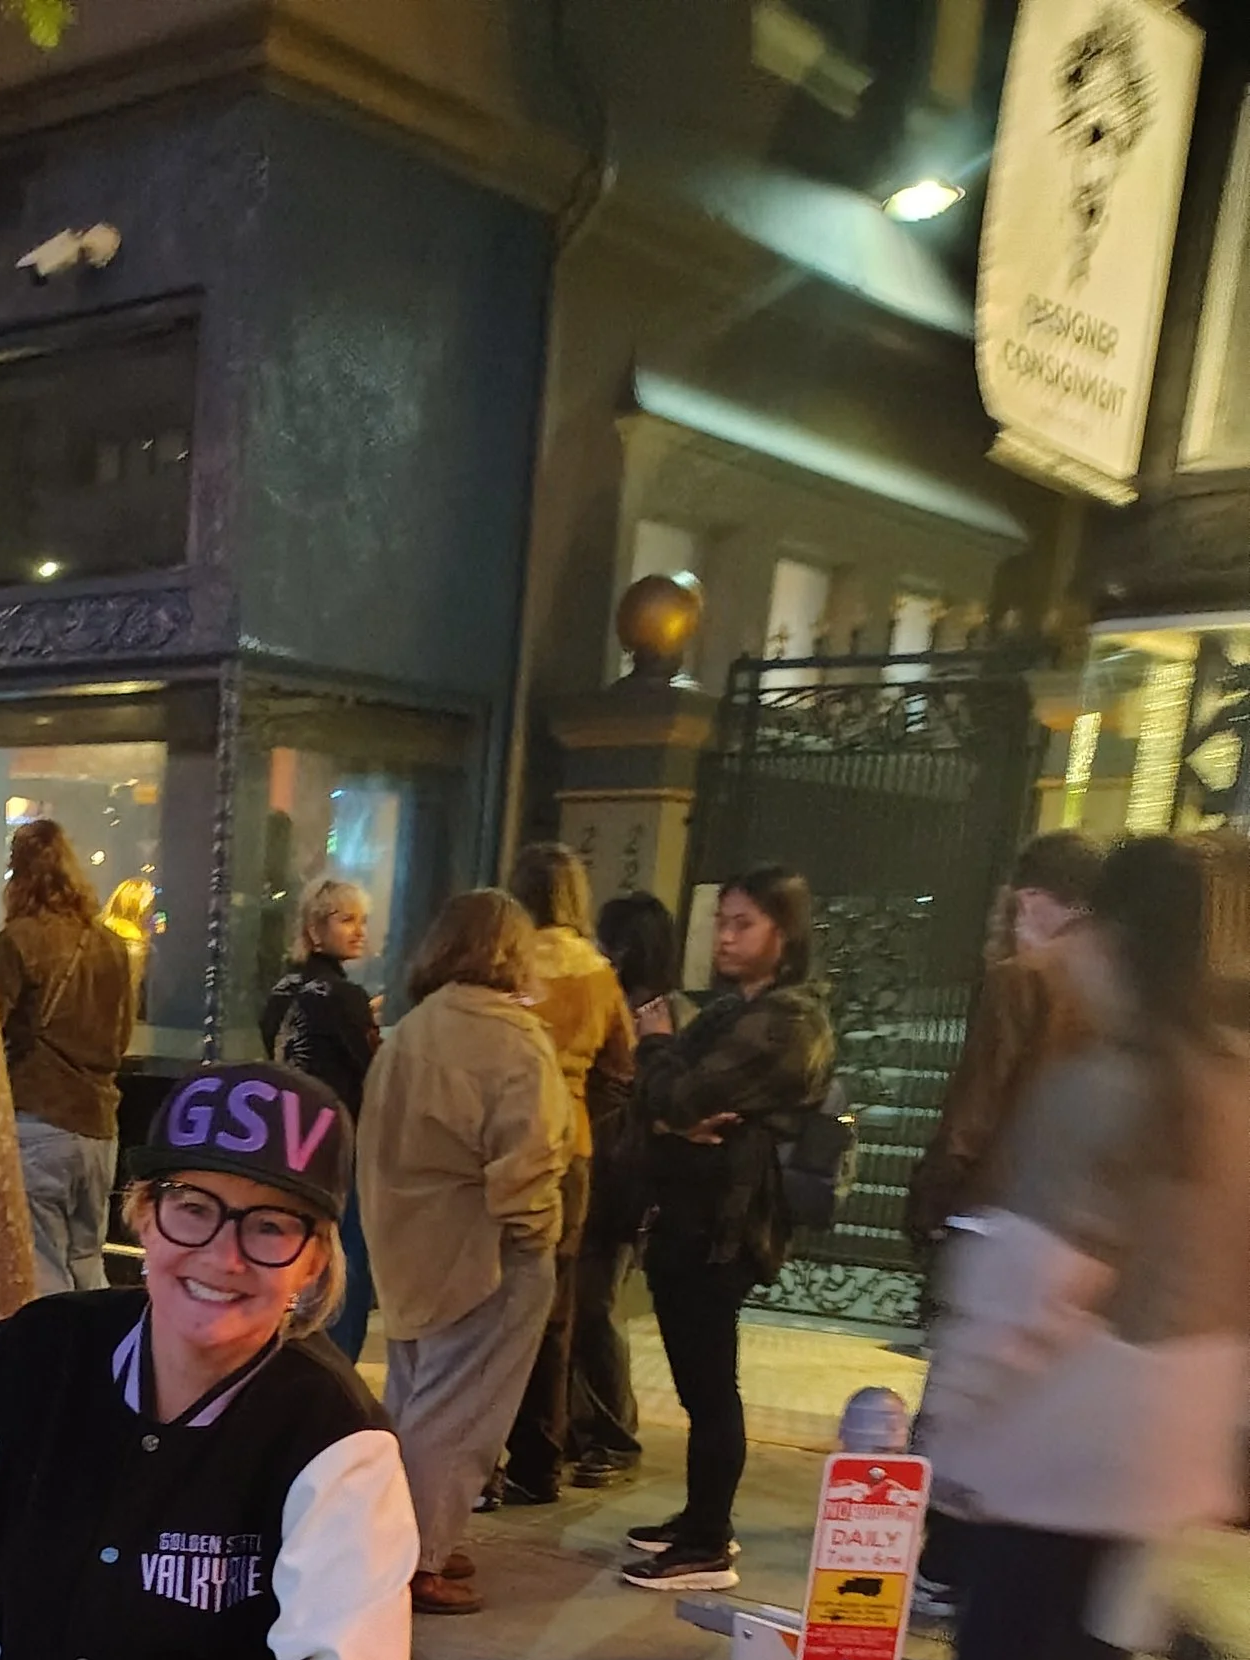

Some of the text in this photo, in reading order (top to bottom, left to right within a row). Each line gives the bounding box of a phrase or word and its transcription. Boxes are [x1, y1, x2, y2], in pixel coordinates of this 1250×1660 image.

[1026, 293, 1119, 358] DESIGNER
[1003, 339, 1128, 417] CONSIGNMENT
[168, 1077, 337, 1173] GSV
[158, 1532, 223, 1554] GOLDEN
[831, 1528, 905, 1549] DAILY
